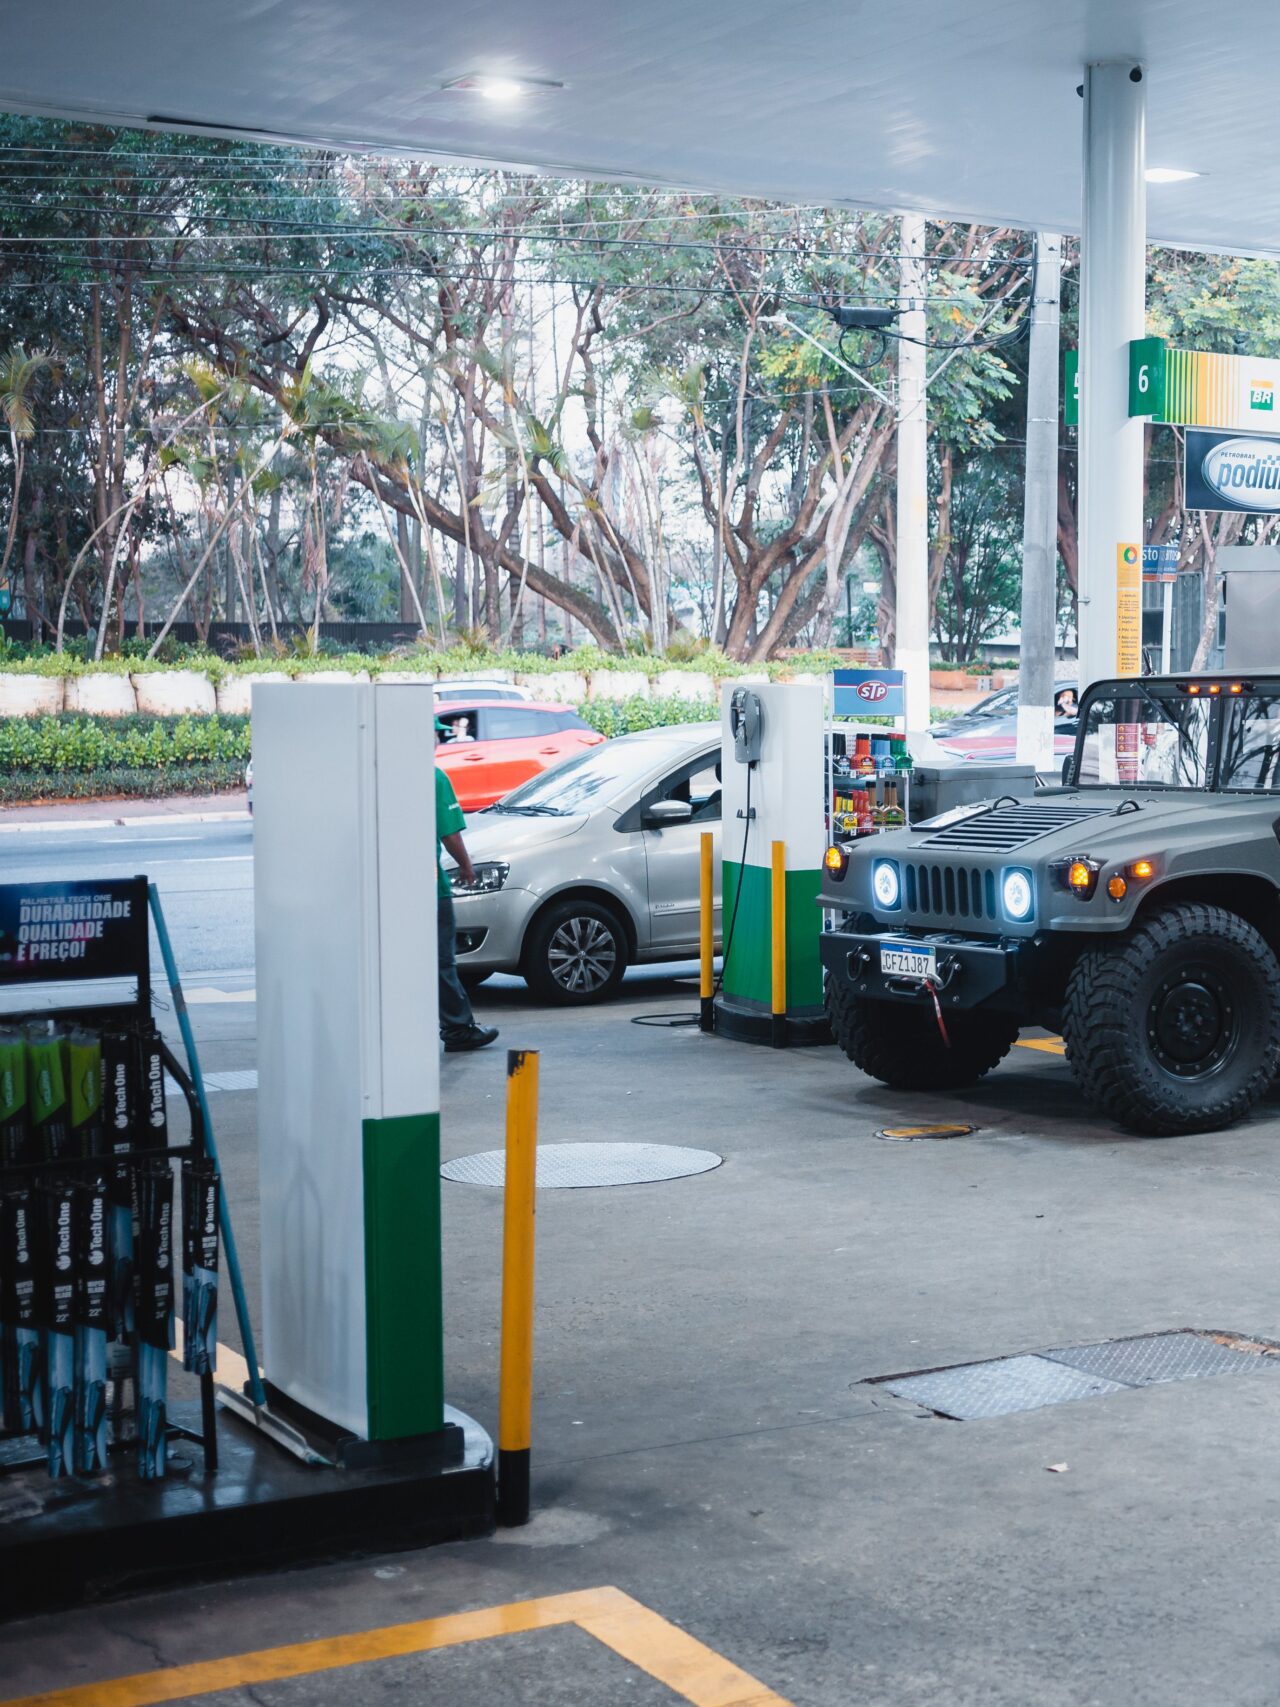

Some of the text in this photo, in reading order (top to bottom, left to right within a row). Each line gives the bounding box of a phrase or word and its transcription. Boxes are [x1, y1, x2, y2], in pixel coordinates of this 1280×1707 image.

[1138, 364, 1149, 393] 6
[1252, 390, 1272, 404] BR
[1220, 451, 1256, 460] PETROBRAS
[860, 683, 886, 699] STP
[20, 900, 131, 923] DURABILIDADE
[68, 895, 92, 903] TECH
[93, 894, 112, 902] ONE
[19, 921, 104, 943] QUALIDADE
[17, 940, 86, 962] E PREÇO!
[885, 953, 929, 974] CFZ1J87
[114, 1063, 127, 1116] Tech One
[149, 1054, 162, 1111] Tech One
[205, 1186, 215, 1222] Tech One
[16, 1209, 27, 1251] Tech One
[58, 1202, 70, 1255] Tech One
[90, 1198, 103, 1250] Tech One
[157, 1202, 170, 1255] Tech One
